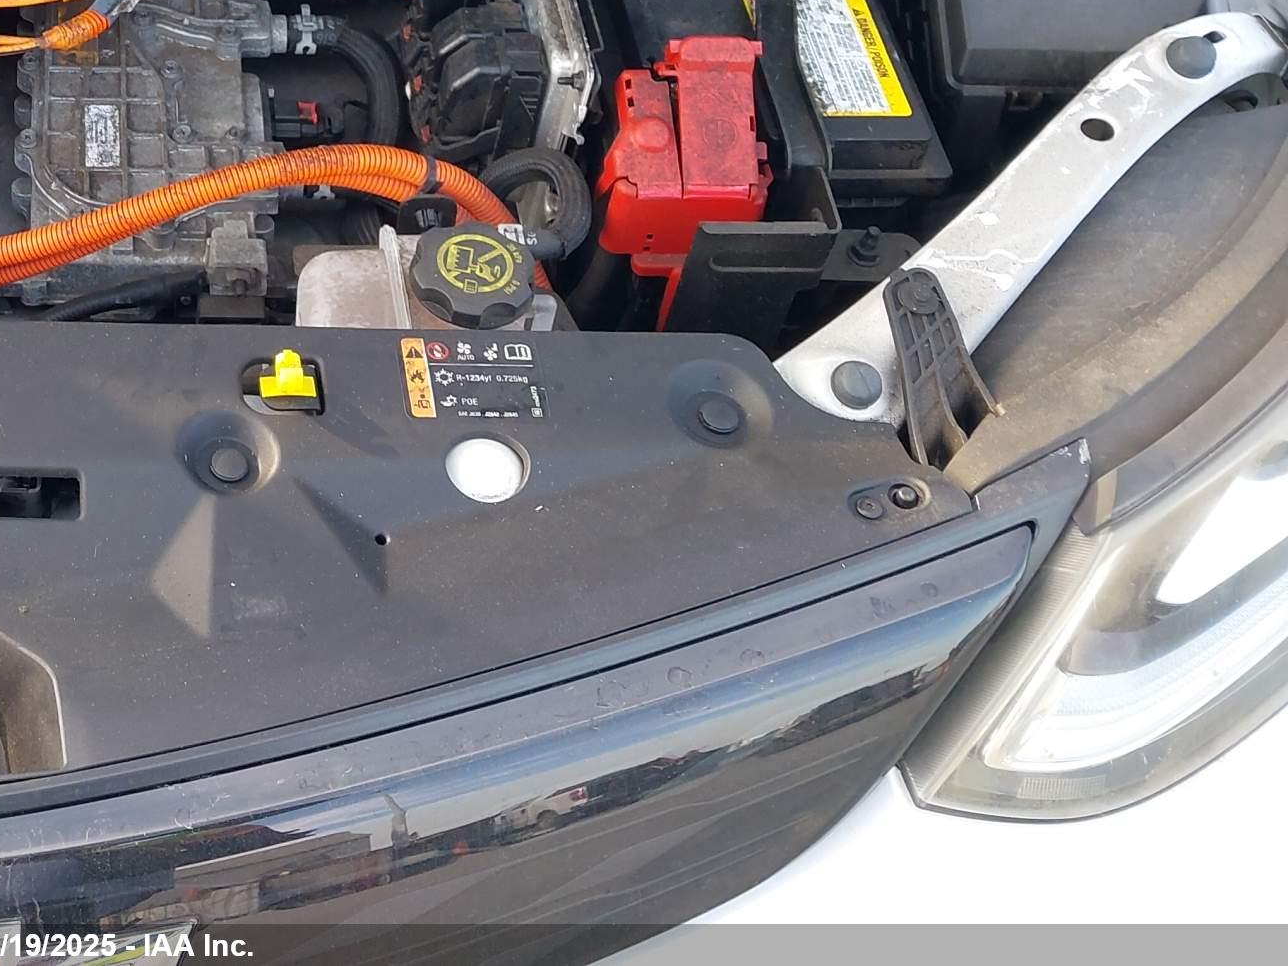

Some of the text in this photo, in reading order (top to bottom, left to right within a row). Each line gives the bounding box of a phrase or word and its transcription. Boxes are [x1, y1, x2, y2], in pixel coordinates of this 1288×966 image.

[856, 17, 876, 47] DANGER
[871, 50, 889, 79] POISON
[461, 397, 479, 406] POE
